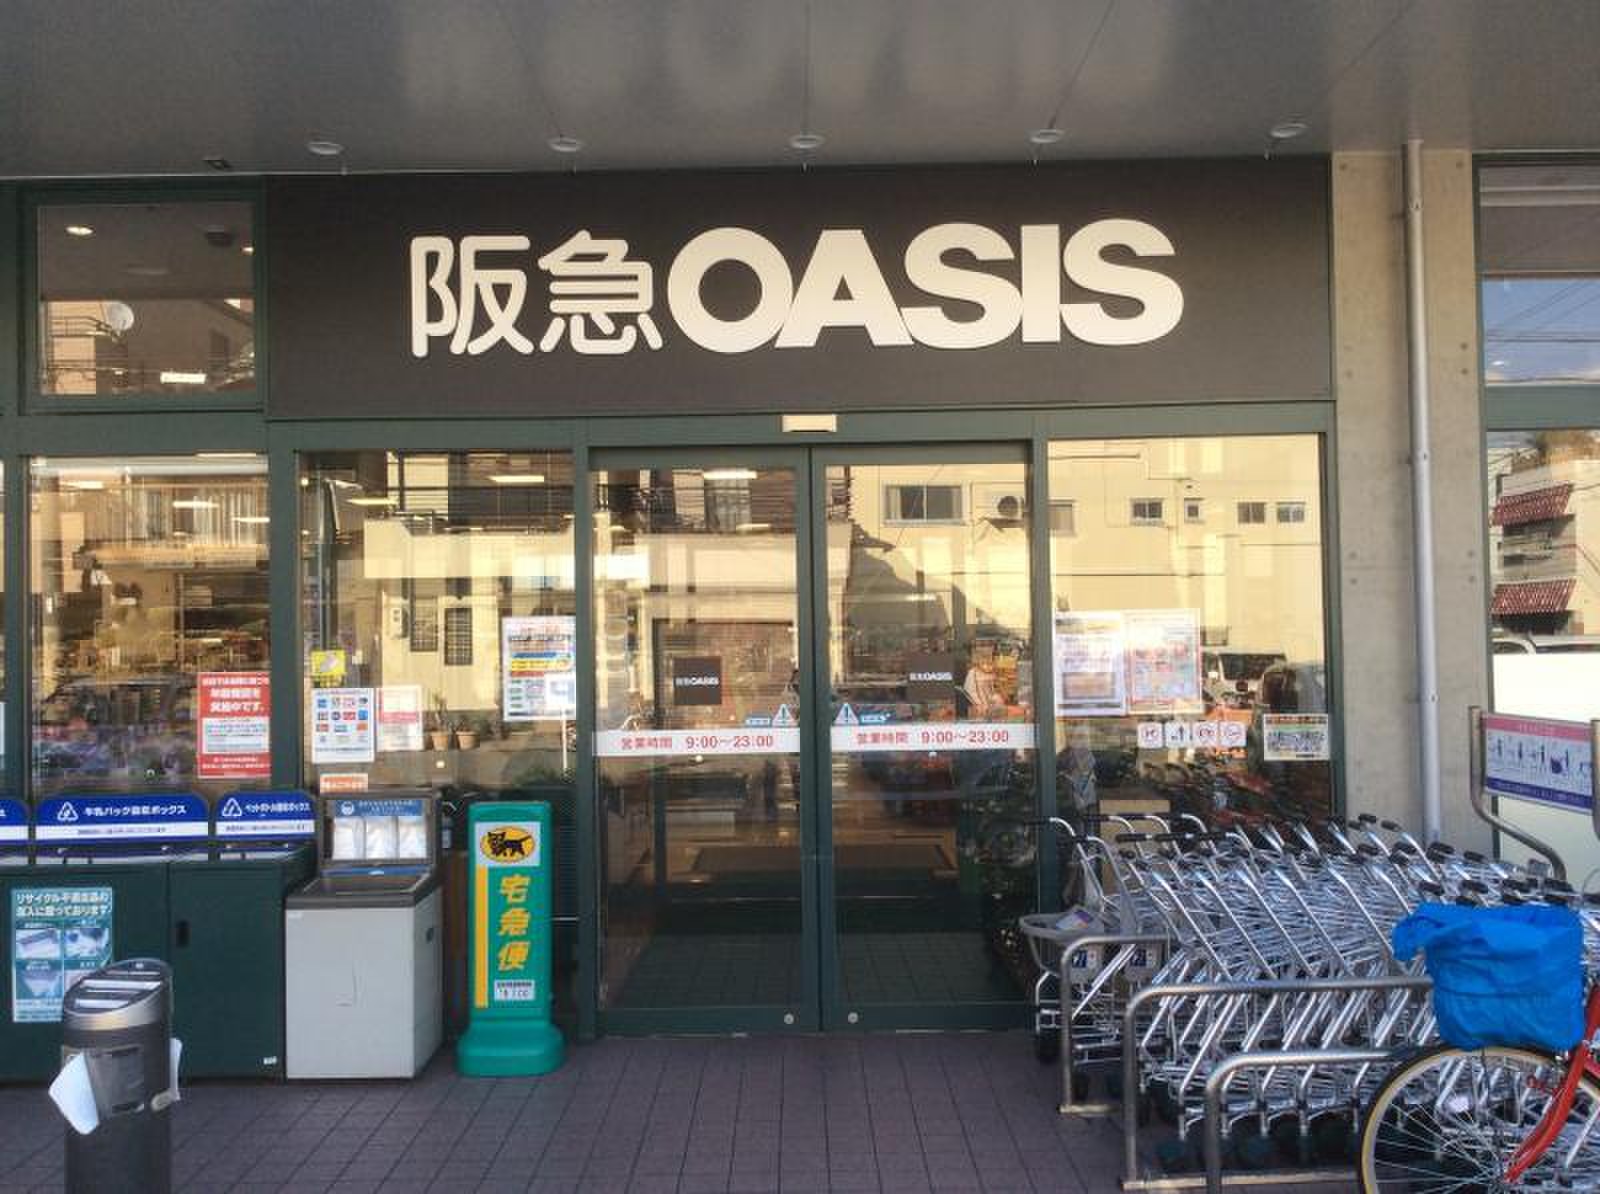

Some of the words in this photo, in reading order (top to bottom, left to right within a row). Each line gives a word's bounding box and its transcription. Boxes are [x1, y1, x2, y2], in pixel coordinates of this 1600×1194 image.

[620, 736, 673, 750] 営業時間
[856, 731, 909, 745] 営業時間
[496, 873, 532, 972] 宅急便
